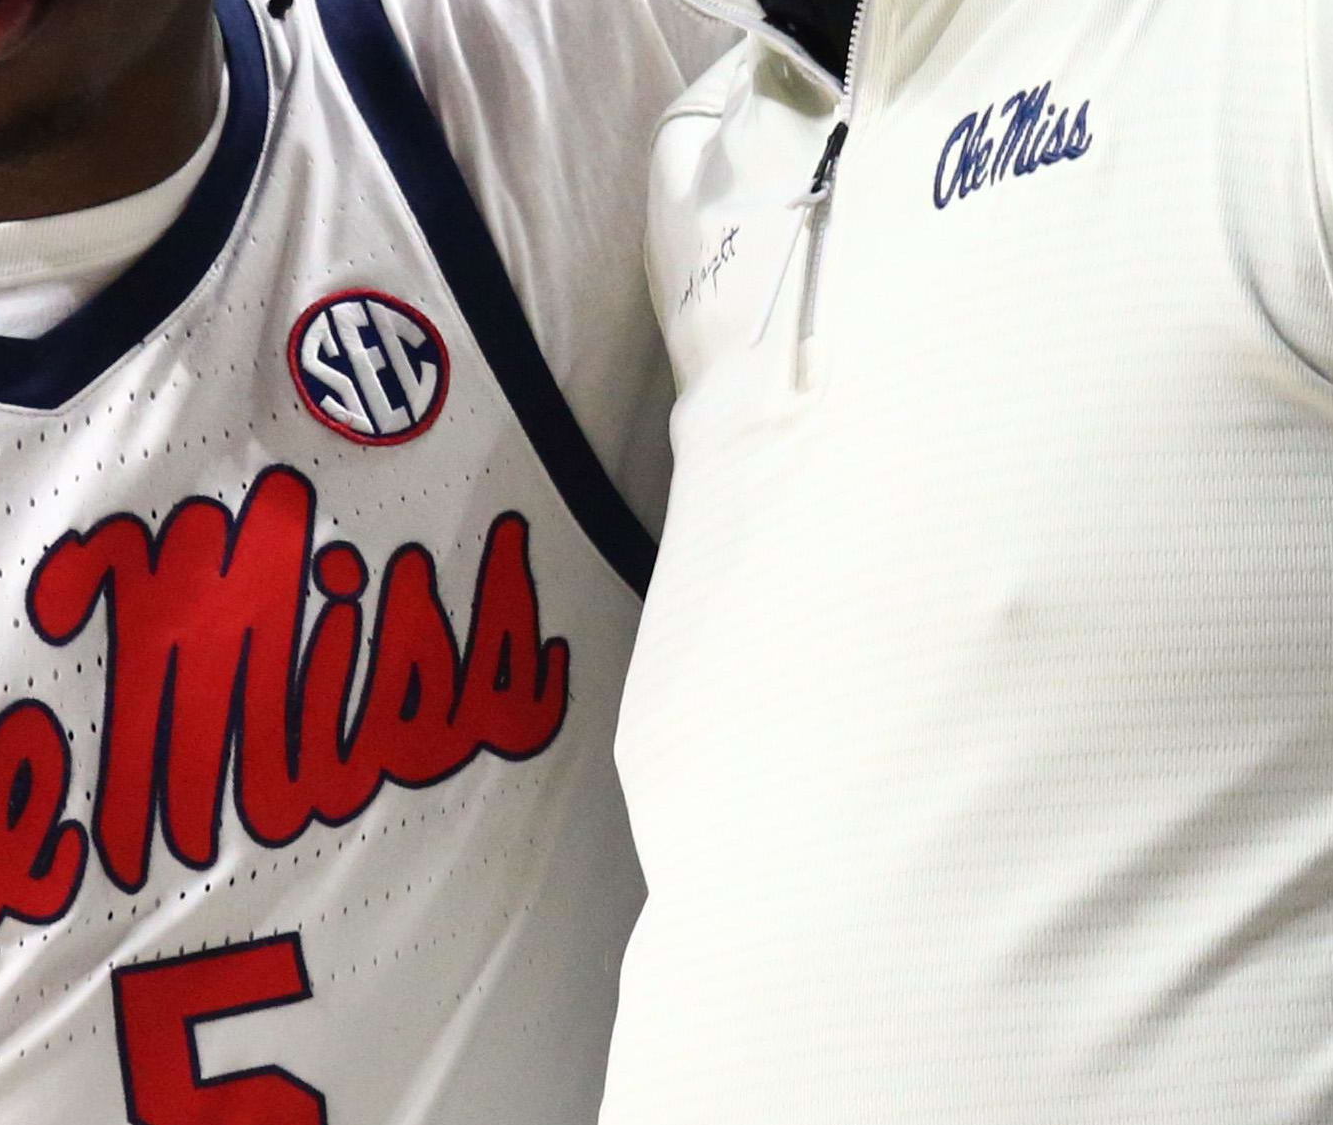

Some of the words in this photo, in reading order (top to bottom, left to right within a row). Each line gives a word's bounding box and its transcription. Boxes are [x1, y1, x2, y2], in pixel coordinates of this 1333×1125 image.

[933, 102, 994, 210] Ole
[990, 80, 1093, 187] Miss
[300, 298, 438, 435] SEC
[26, 463, 570, 895] Miss
[111, 931, 328, 1125] 5
